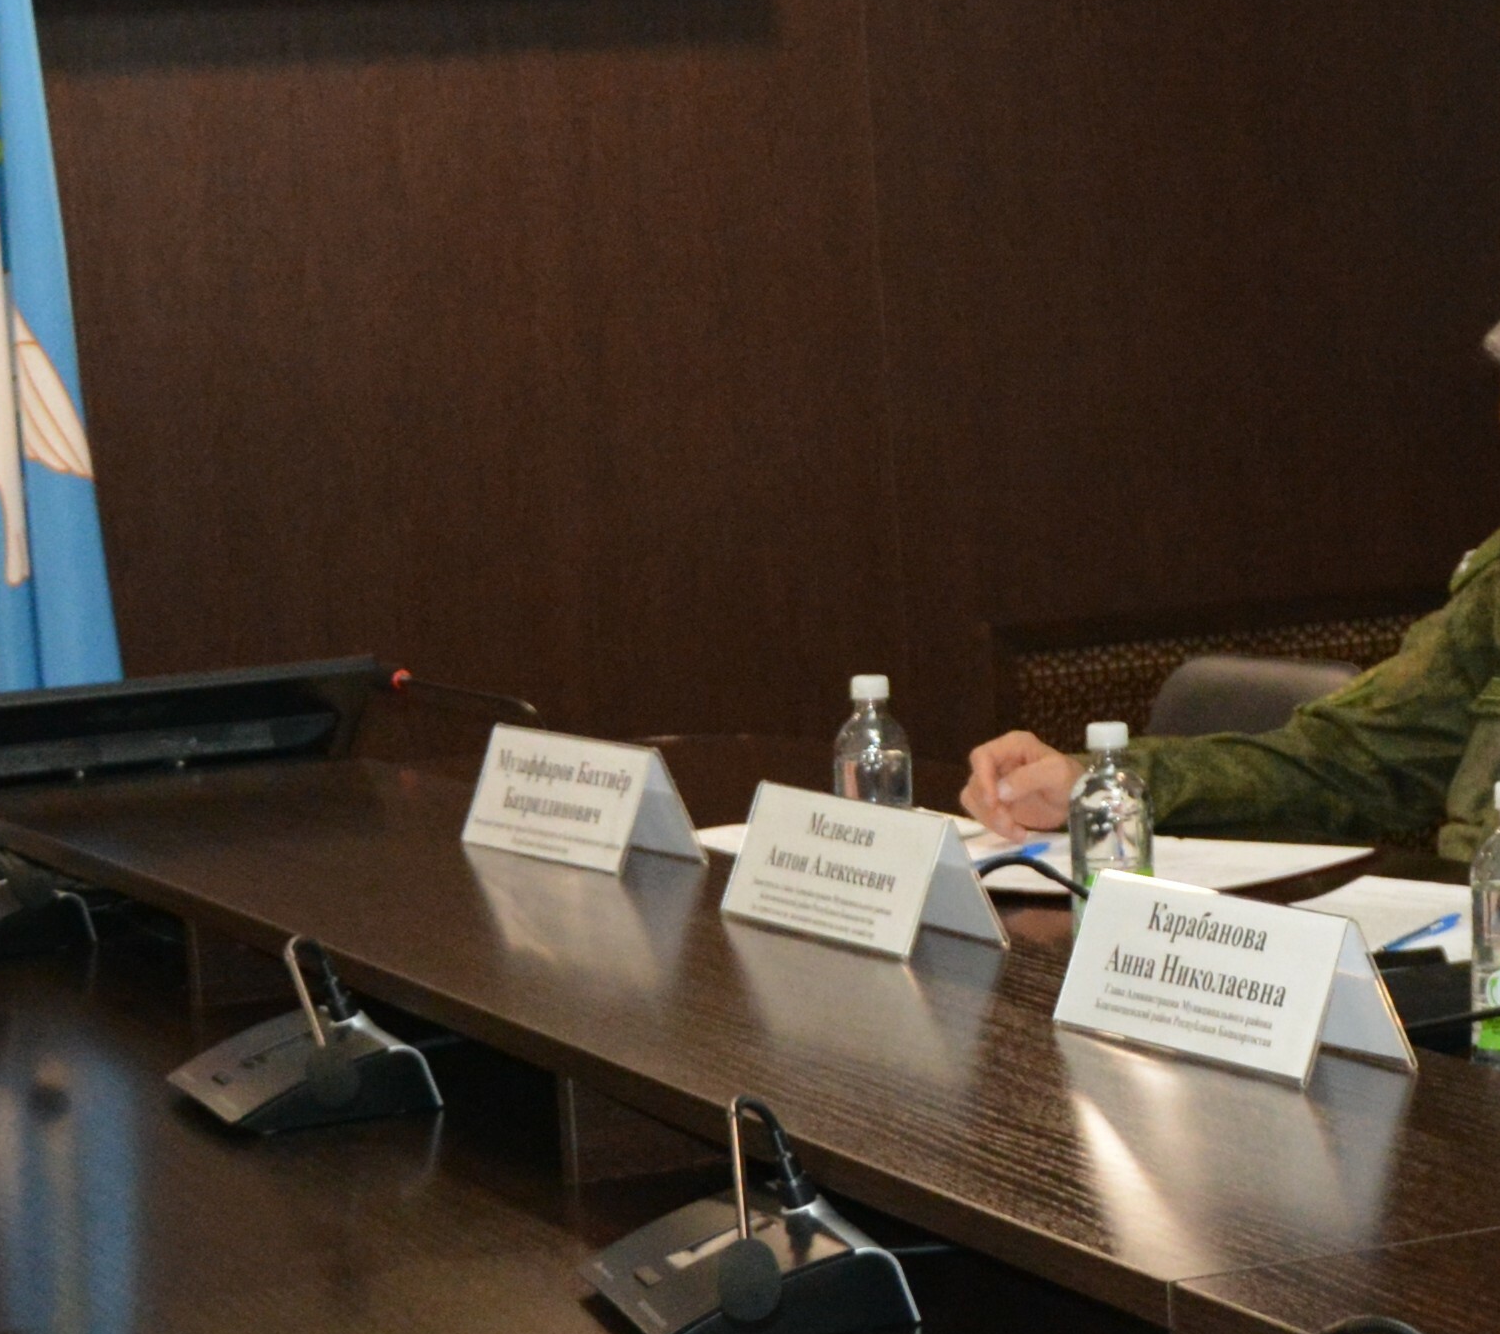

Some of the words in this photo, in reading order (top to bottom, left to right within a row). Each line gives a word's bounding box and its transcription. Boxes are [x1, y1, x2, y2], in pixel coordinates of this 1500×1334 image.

[806, 811, 875, 847] Медведев
[764, 844, 810, 873] Антон
[809, 854, 896, 893] Алексеевич
[1147, 901, 1268, 952] Карабанова
[1104, 943, 1156, 979] Анна
[1160, 953, 1286, 1008] Николаевна
